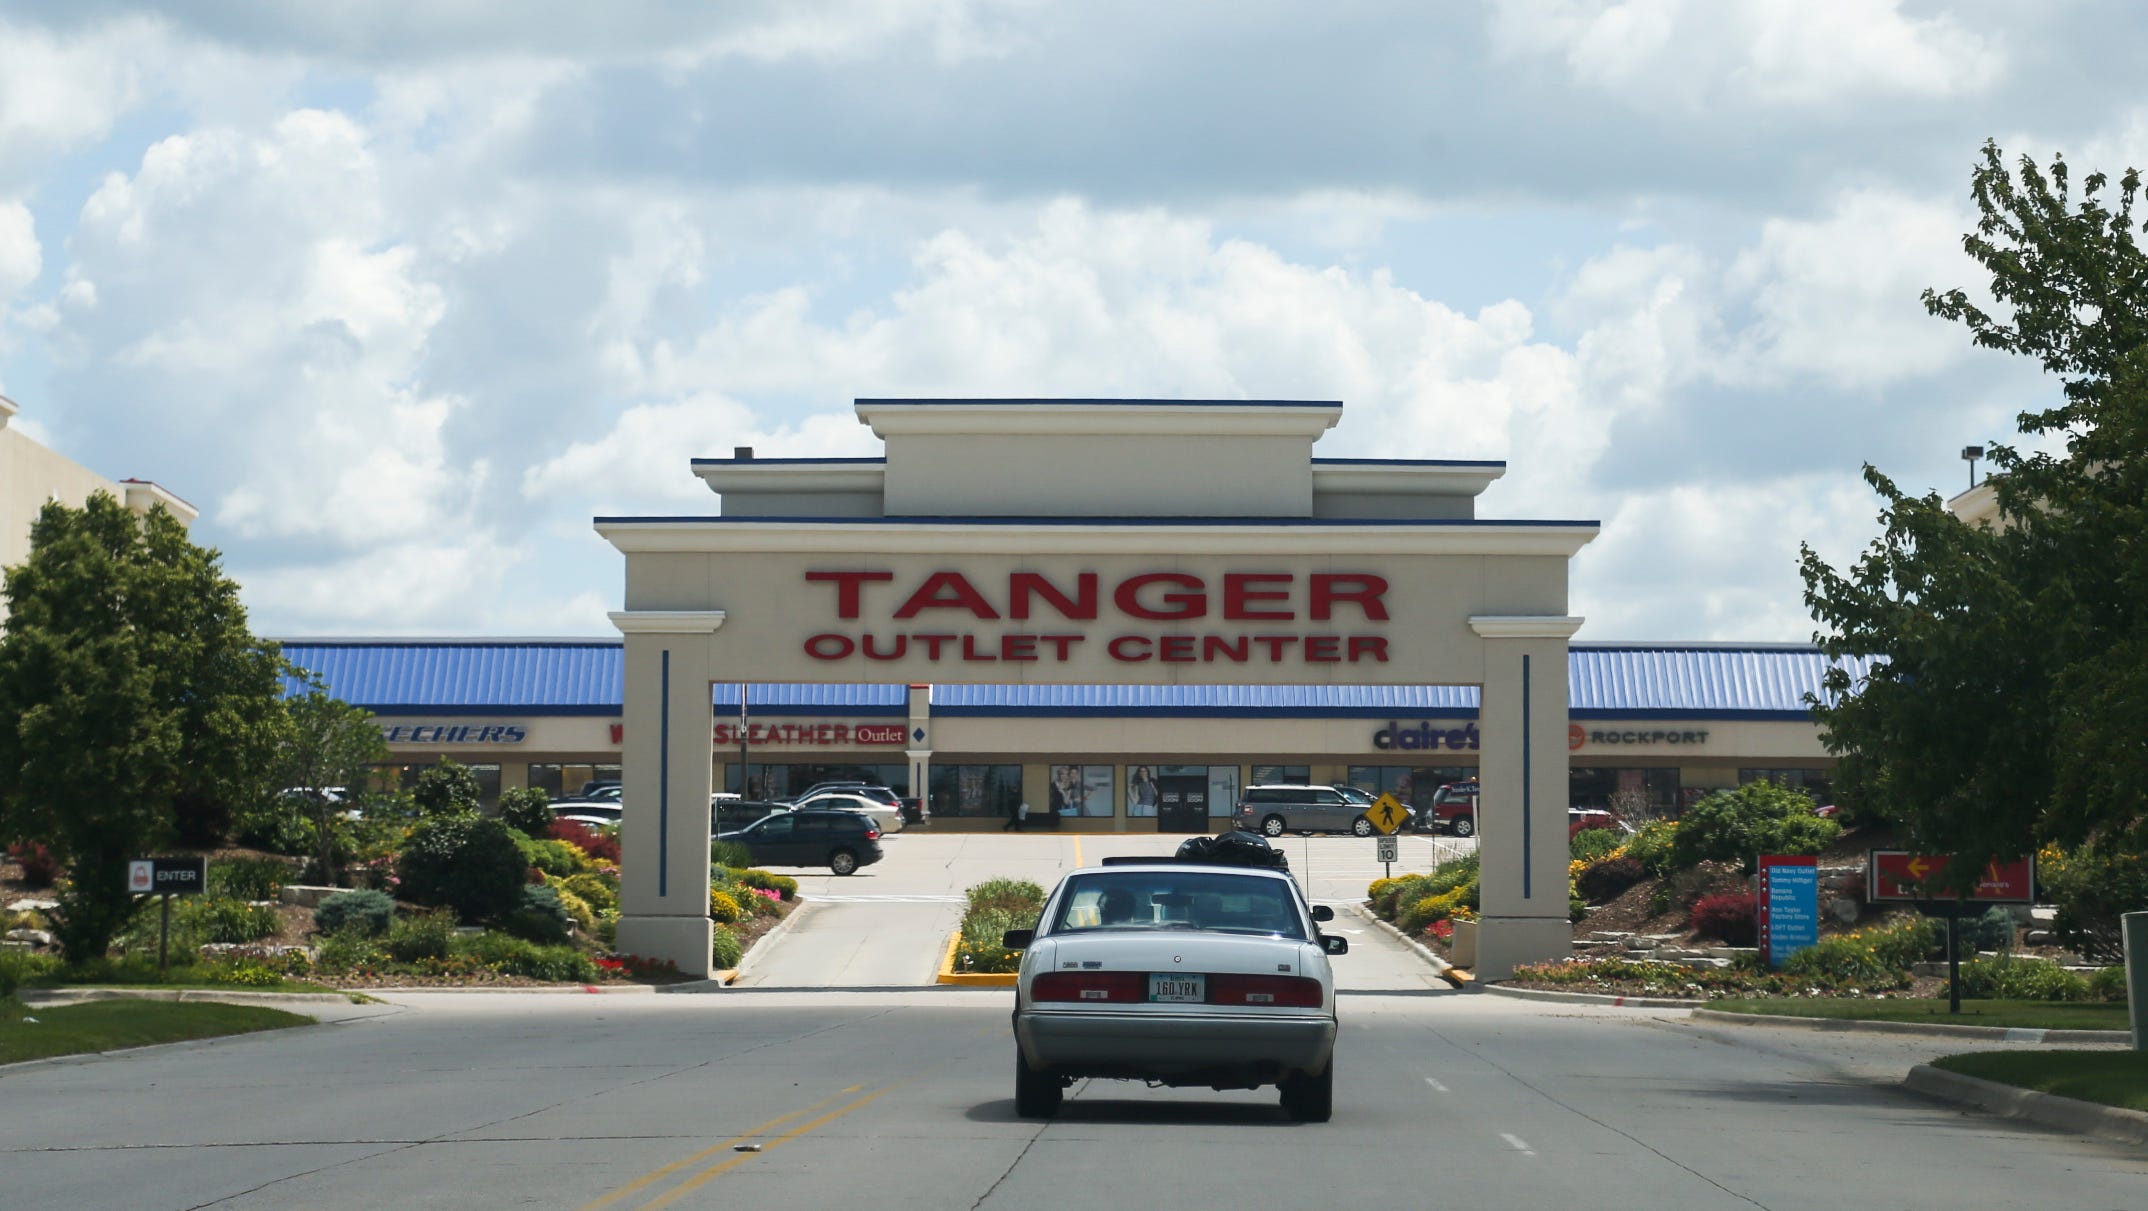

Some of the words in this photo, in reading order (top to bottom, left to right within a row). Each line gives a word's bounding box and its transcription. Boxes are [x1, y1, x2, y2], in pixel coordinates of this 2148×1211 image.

[805, 572, 1390, 620] TANGER
[804, 634, 1085, 661] OUTLET
[1107, 635, 1389, 662] CENTER
[858, 728, 902, 742] Outlet
[1591, 731, 1710, 744] ROCKPORT
[1381, 850, 1394, 859] 10
[157, 870, 196, 880] ENTER
[1782, 868, 1796, 876] Navy
[1157, 982, 1175, 995] 160
[1178, 982, 1197, 996] YRK
